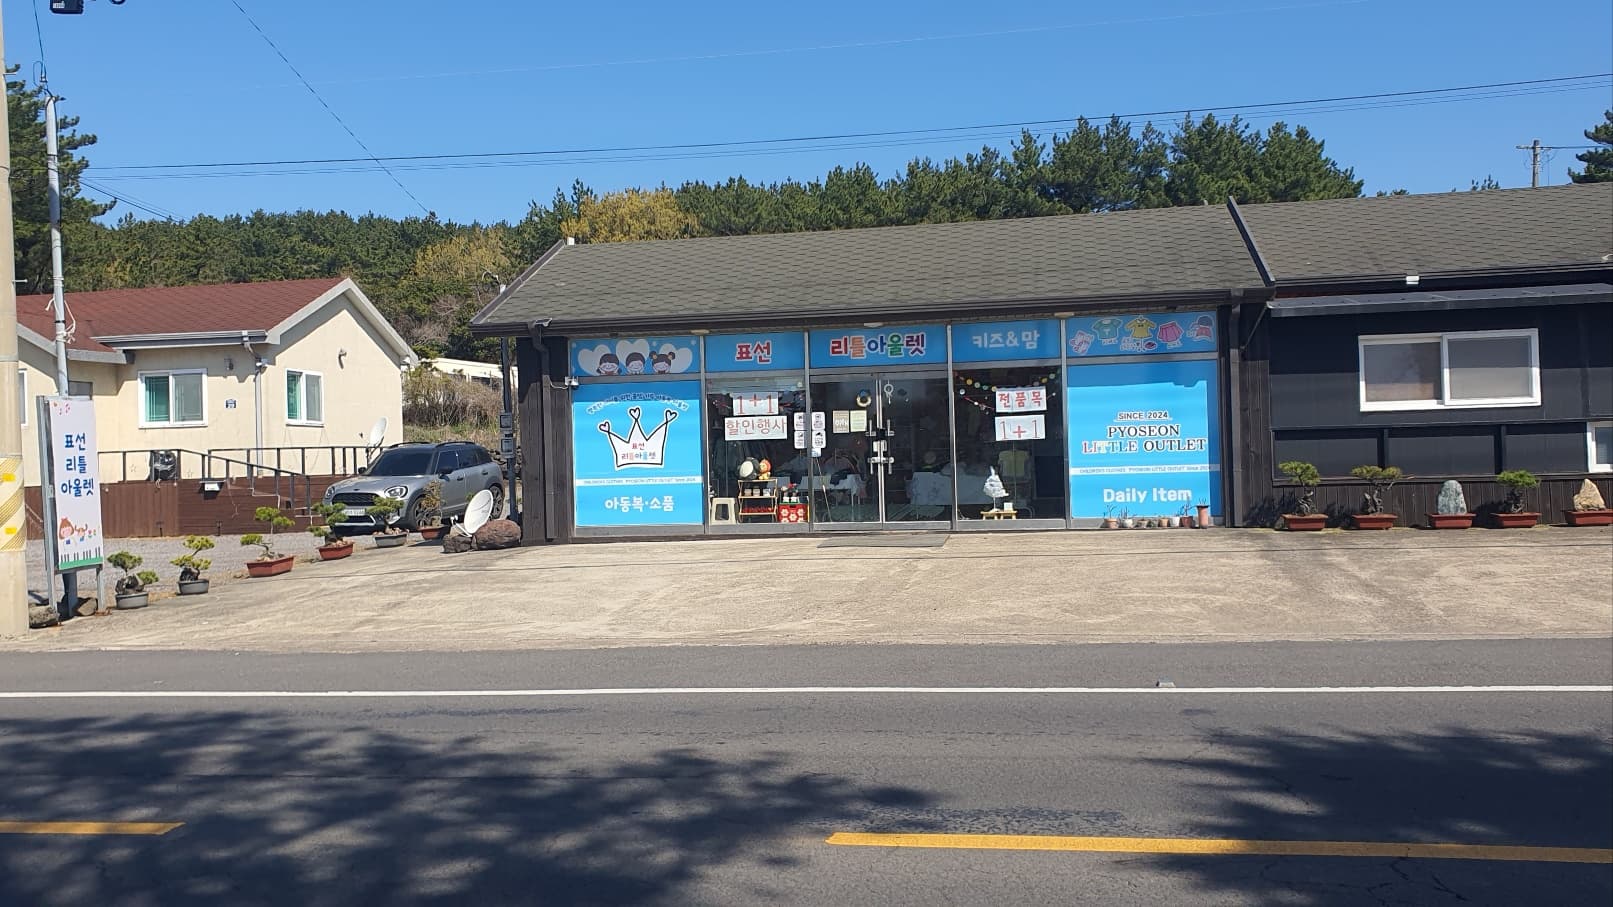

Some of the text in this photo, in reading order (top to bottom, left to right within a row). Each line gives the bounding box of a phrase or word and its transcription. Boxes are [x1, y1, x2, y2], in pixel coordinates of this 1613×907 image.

[735, 330, 1040, 363] 표선 리틀아울렛 키즈&맘
[737, 394, 774, 414] 1+1
[998, 391, 1042, 408] 전품목
[1118, 411, 1168, 420] SINCE 2024
[726, 418, 787, 435] 할인행사
[1000, 420, 1041, 439] 1+1
[1108, 424, 1180, 437] PYOSEON
[65, 432, 86, 451] 표선
[1083, 438, 1206, 453] LITTLE OUTLET
[66, 455, 87, 474] 리틀
[61, 478, 94, 498] 아울렛
[1103, 487, 1192, 503] Daily Item
[604, 495, 674, 513] 아동복·소품
